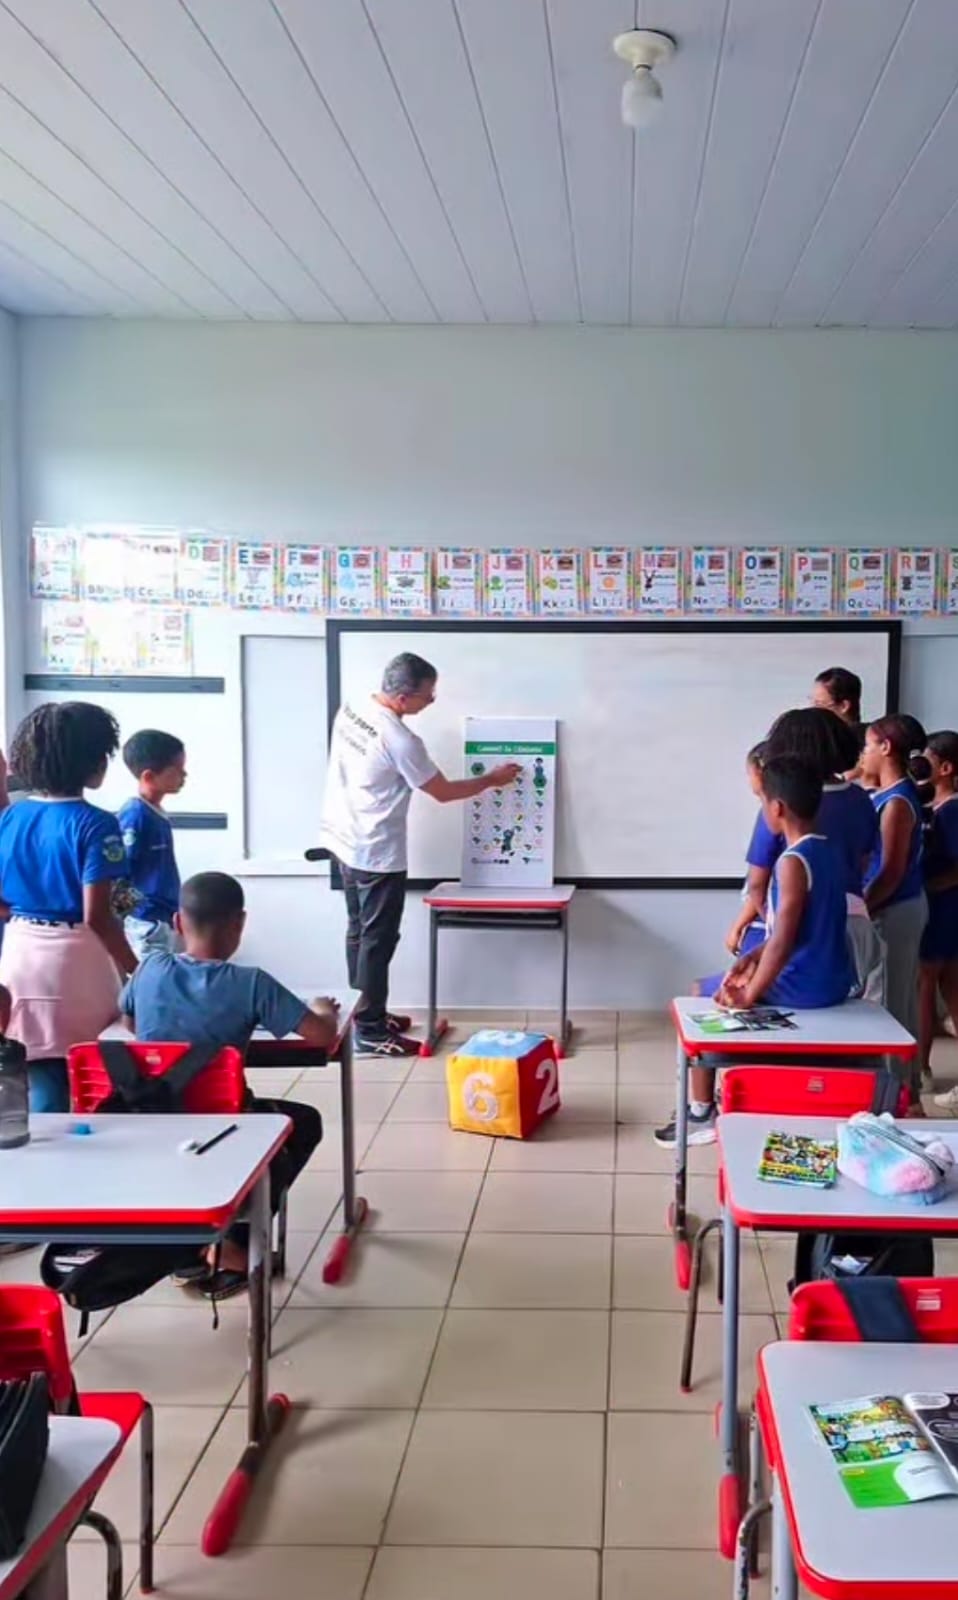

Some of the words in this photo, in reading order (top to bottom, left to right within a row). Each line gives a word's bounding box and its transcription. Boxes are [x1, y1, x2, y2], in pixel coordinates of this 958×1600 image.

[189, 546, 199, 560] D
[238, 549, 249, 564] E
[287, 551, 298, 566] F
[338, 553, 350, 568] G
[401, 554, 412, 569] H
[443, 554, 448, 569] I
[492, 554, 501, 570] J
[543, 554, 554, 570] K
[593, 554, 603, 568] L
[643, 554, 657, 568] M
[694, 554, 705, 569] N
[745, 555, 757, 570] O
[798, 556, 808, 570] P
[849, 556, 860, 571] Q
[901, 555, 912, 569] R
[535, 1058, 560, 1115] 2
[463, 1072, 498, 1122] 6
